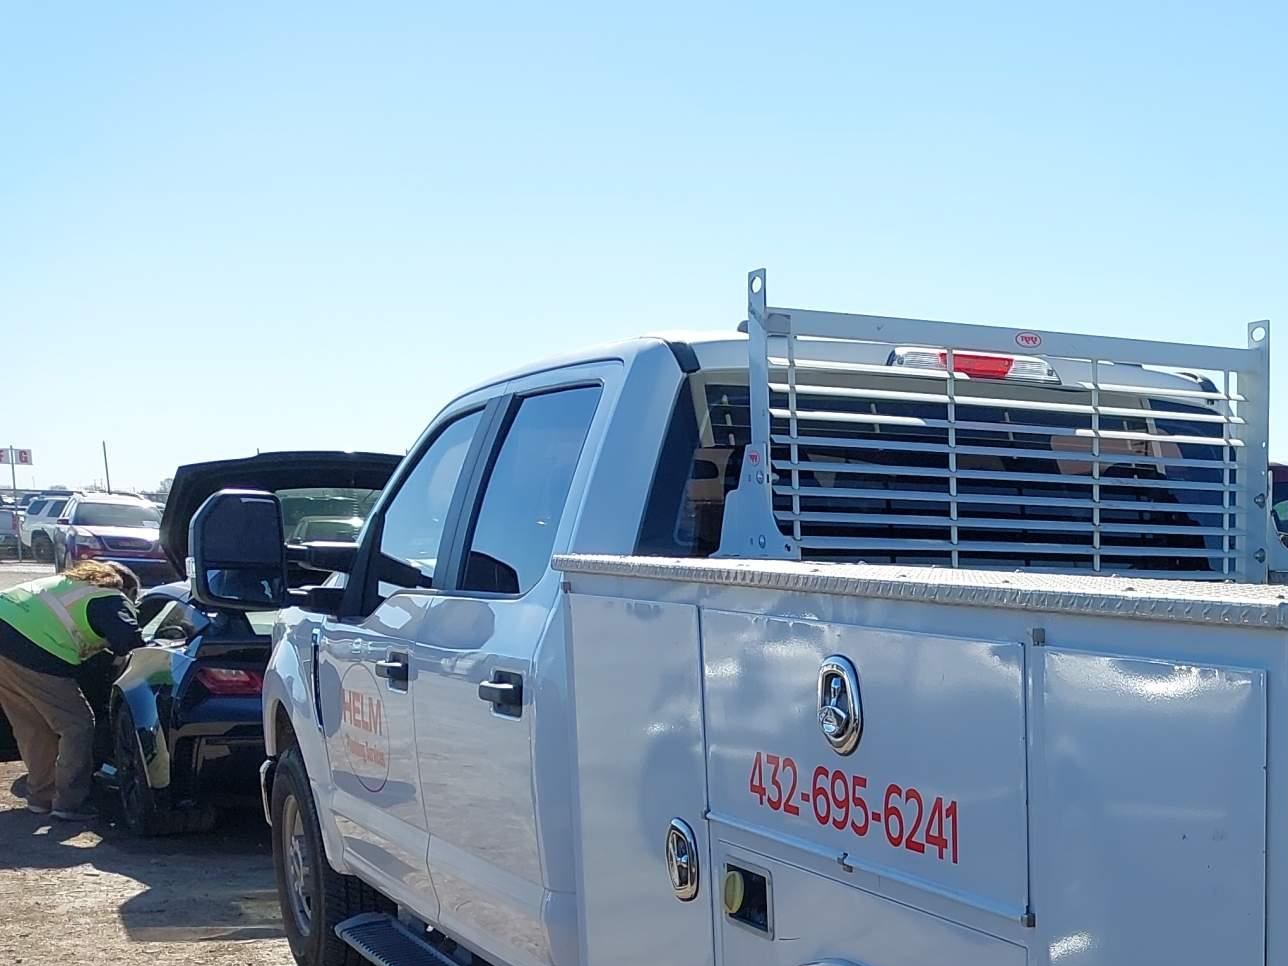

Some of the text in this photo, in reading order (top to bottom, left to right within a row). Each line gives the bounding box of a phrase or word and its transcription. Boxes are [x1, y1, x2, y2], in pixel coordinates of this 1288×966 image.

[19, 450, 28, 463] G
[342, 687, 382, 736] HELM
[750, 752, 958, 864] 432-695-6241
